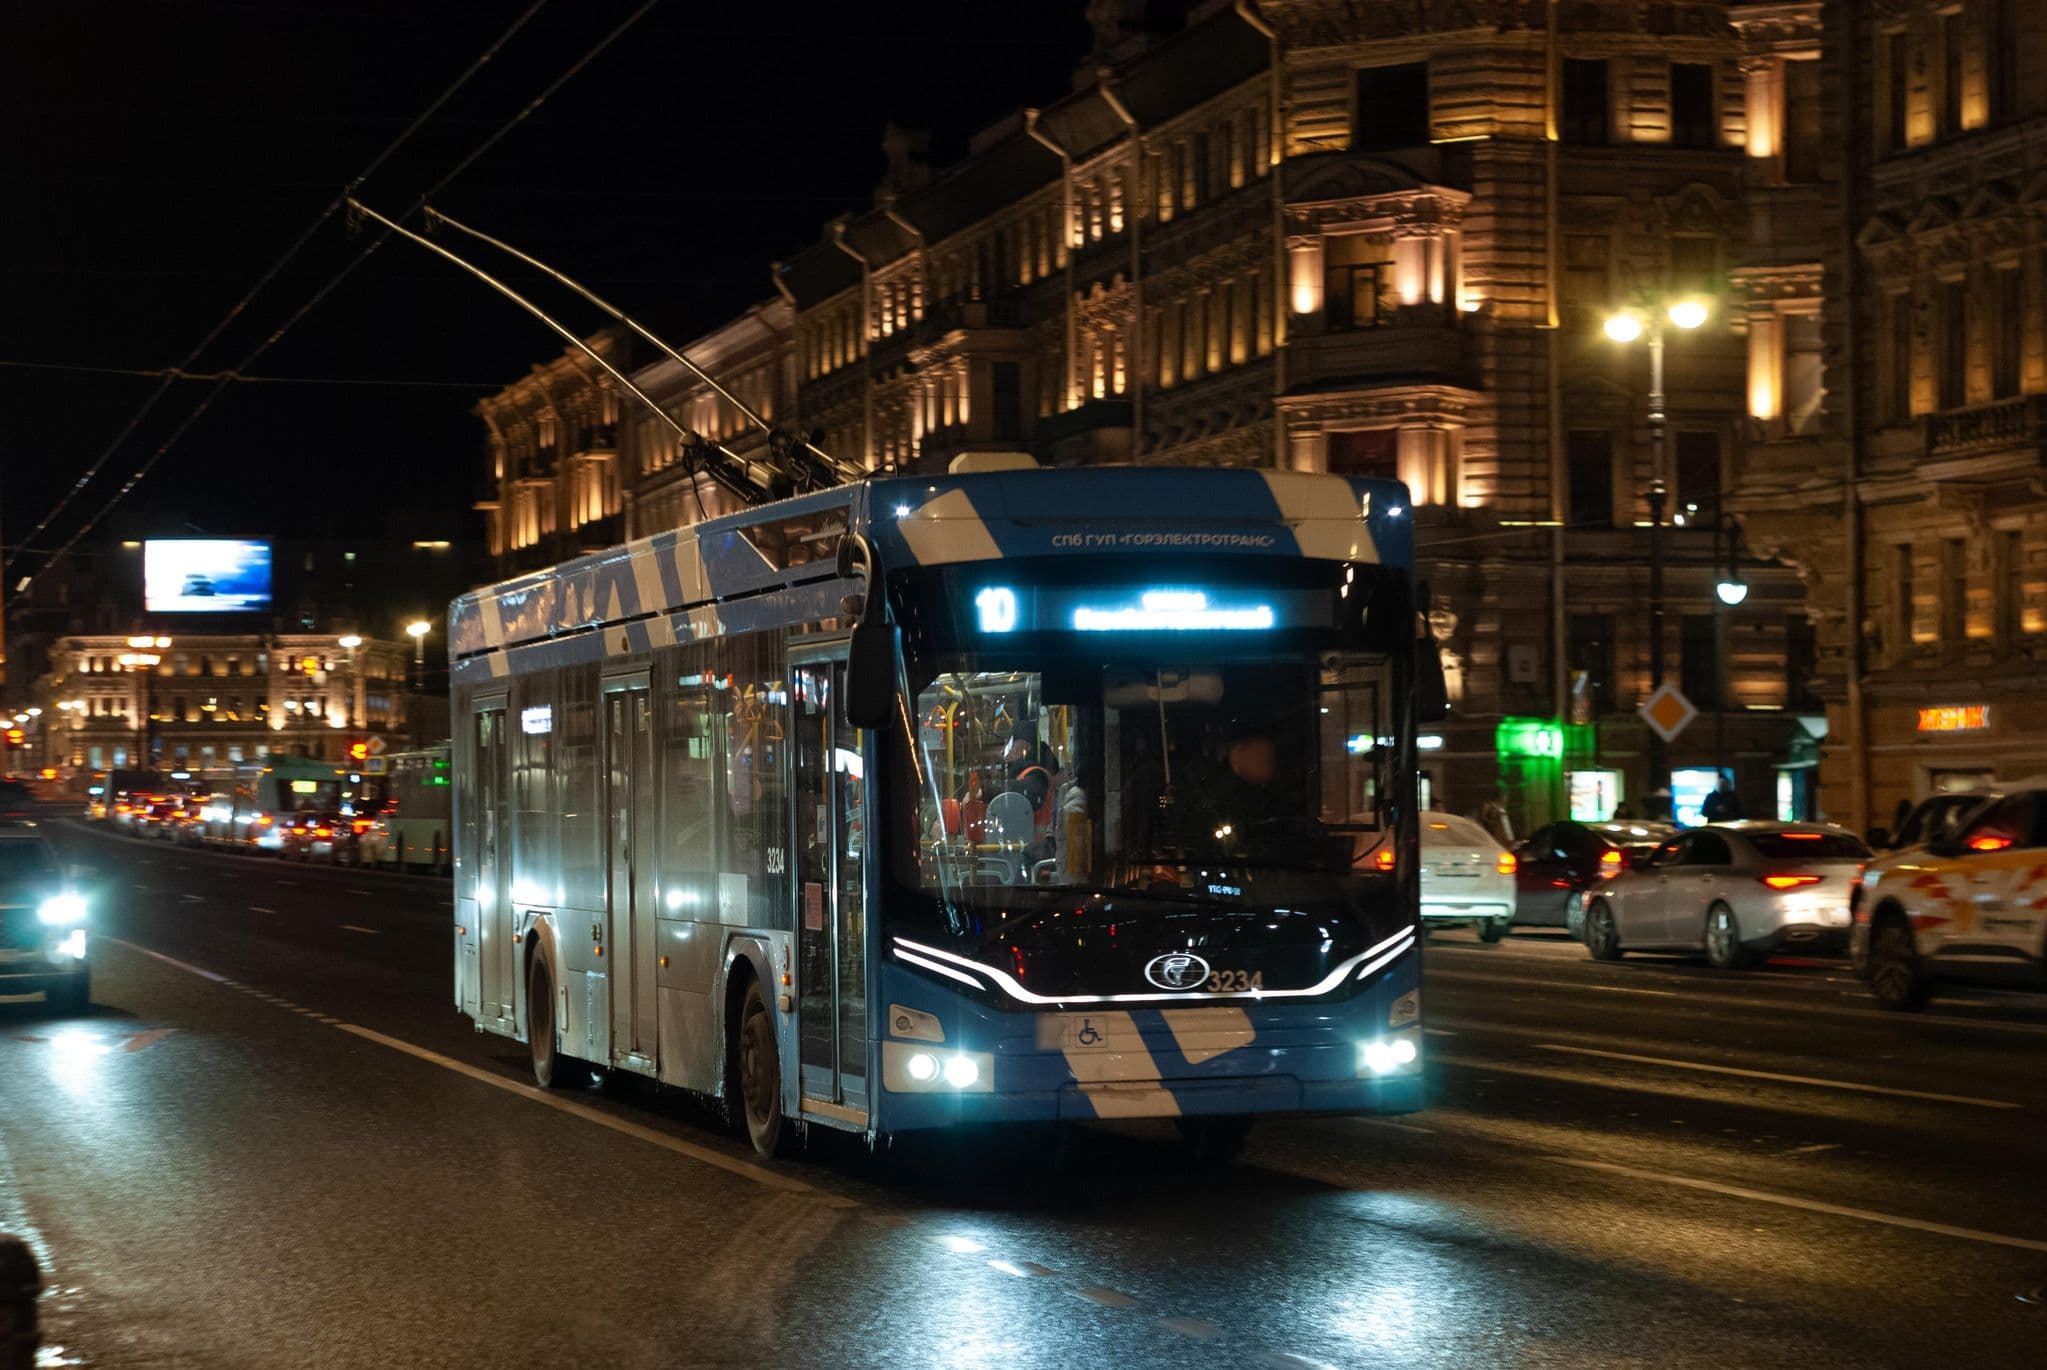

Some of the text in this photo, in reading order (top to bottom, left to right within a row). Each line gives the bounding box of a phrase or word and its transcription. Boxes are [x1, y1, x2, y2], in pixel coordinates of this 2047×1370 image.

[1086, 533, 1117, 546] ГУП
[976, 589, 1014, 631] 10
[766, 847, 785, 874] 3234
[1207, 970, 1263, 991] 3234
